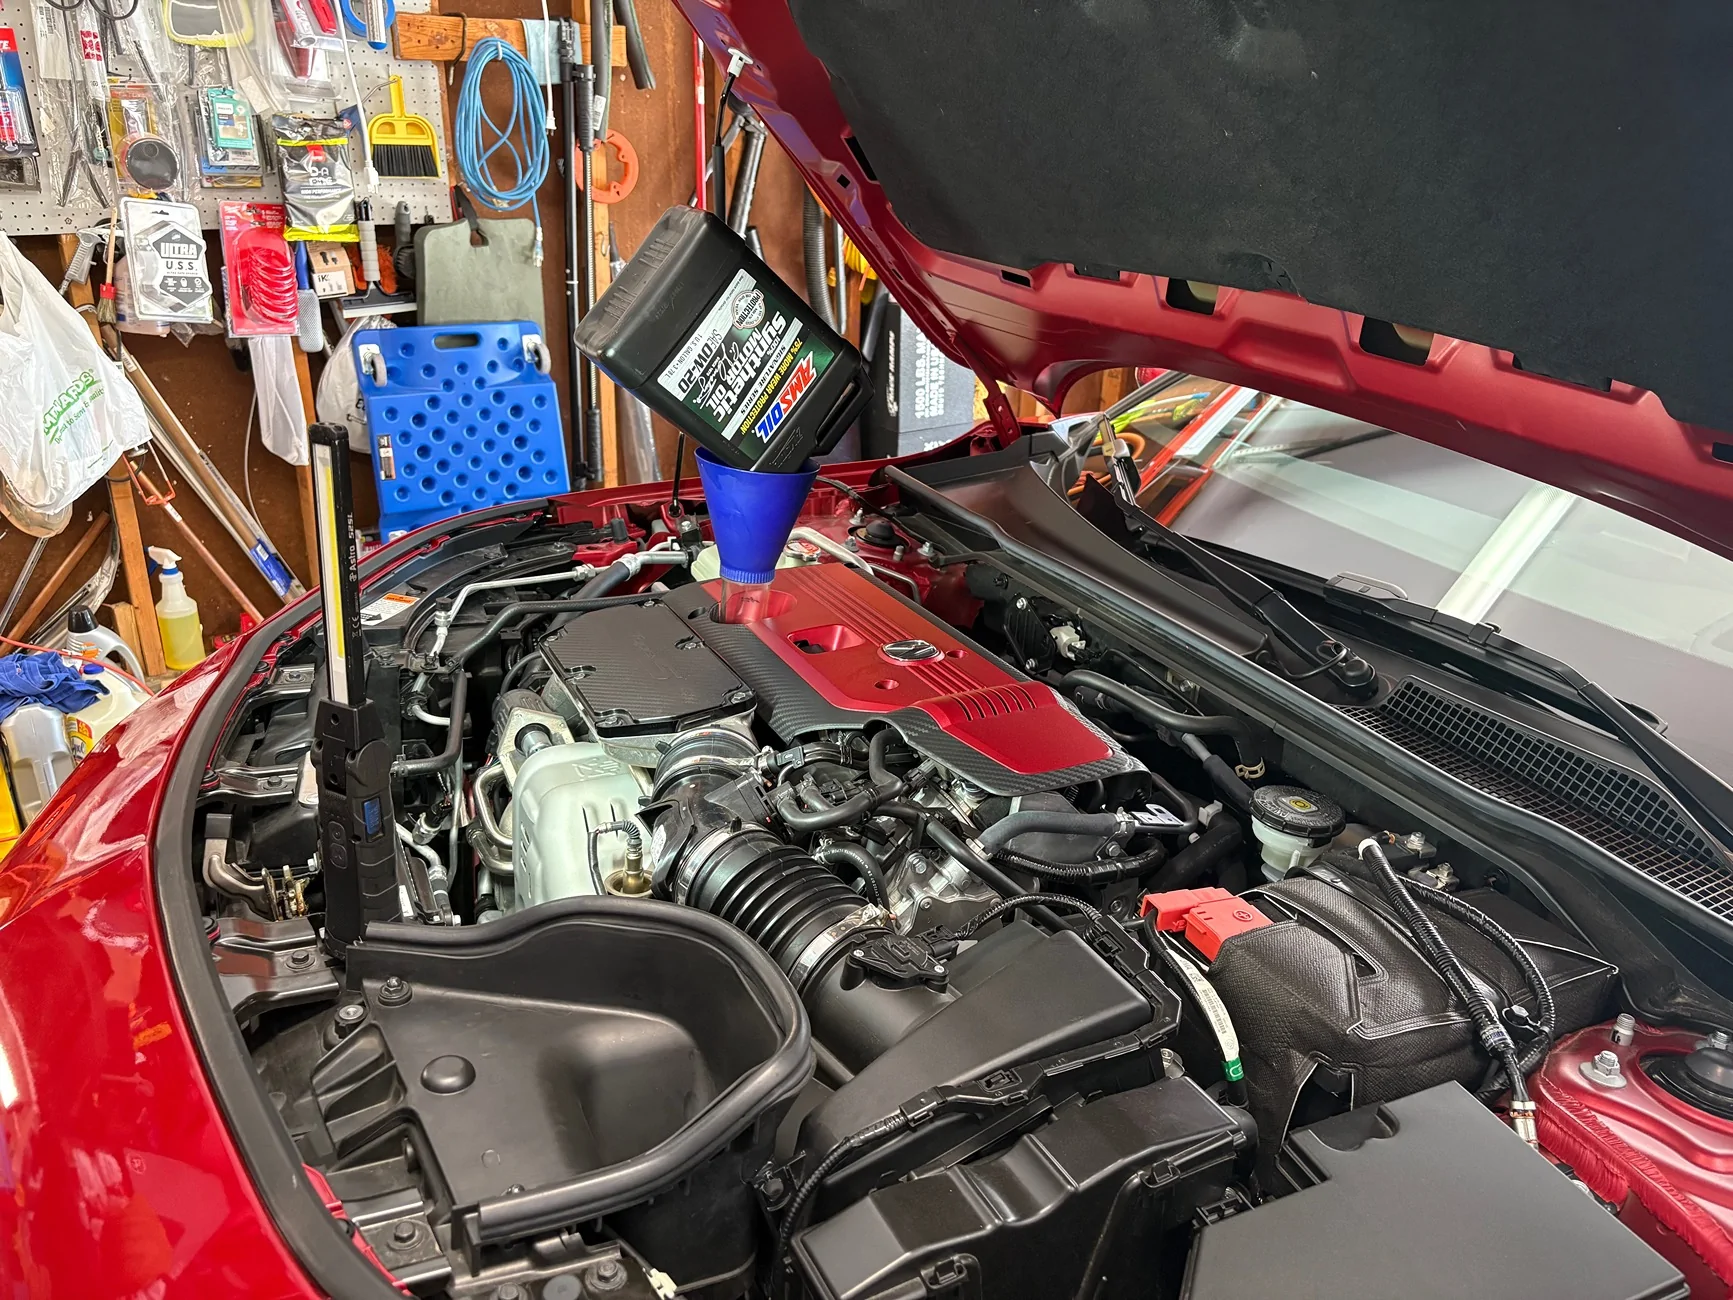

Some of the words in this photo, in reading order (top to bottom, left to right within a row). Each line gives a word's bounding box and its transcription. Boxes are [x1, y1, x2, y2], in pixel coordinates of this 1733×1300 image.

[160, 242, 197, 258] ULTRA
[166, 260, 198, 272] U.S.S.
[735, 292, 760, 326] PROTECTION
[706, 328, 722, 349] SAE
[766, 335, 780, 356] 100%
[789, 337, 802, 354] 75%
[676, 345, 693, 364] GALLON
[677, 341, 713, 394] 0W-20
[712, 310, 788, 422] Synthetic
[724, 327, 762, 385] MOTOR
[756, 344, 786, 389] SIGNATURE
[777, 352, 793, 375] MORE
[764, 372, 781, 394] WEAR
[929, 367, 939, 381] IN
[705, 383, 727, 411] OIL
[739, 387, 759, 415] SERIES
[755, 353, 817, 443] AMSOIL
[914, 387, 926, 418] 1500
[929, 382, 939, 416] MADE
[348, 545, 357, 571] Astro
